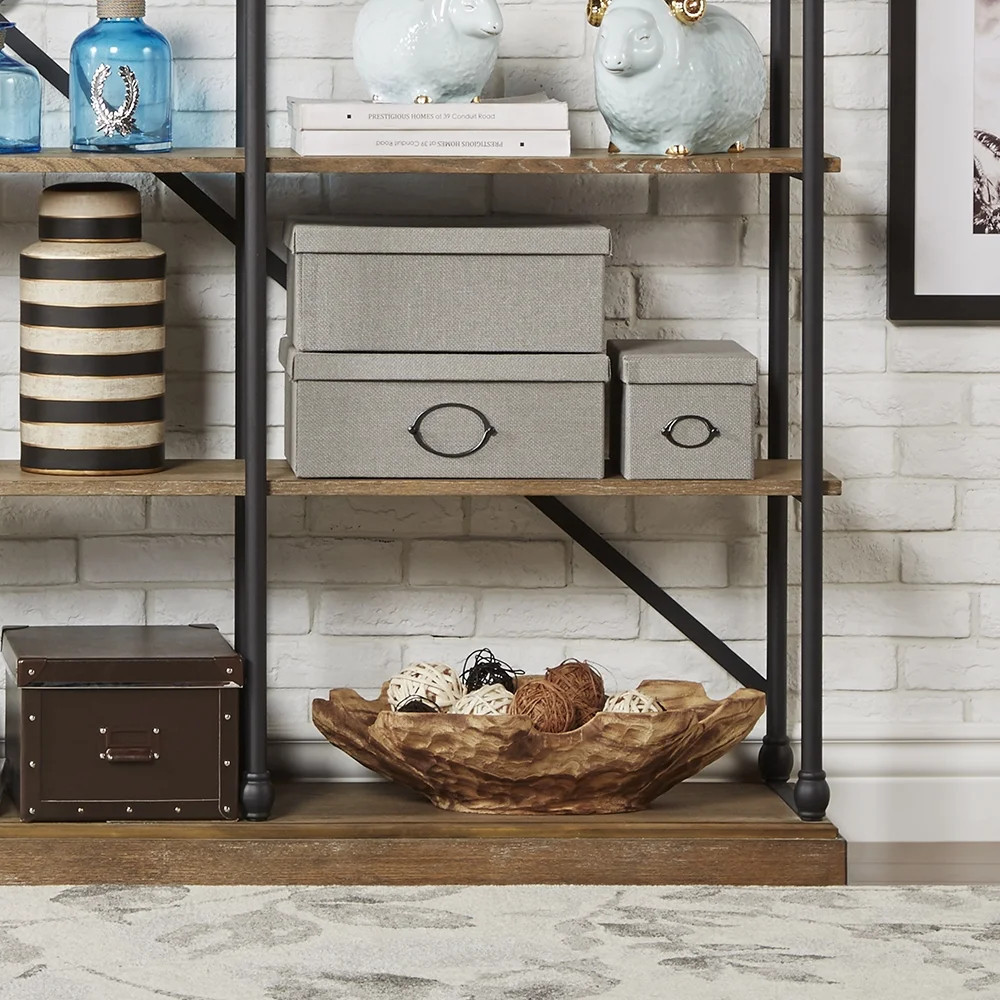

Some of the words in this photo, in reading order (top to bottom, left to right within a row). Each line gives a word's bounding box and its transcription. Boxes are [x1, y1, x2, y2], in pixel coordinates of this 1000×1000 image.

[368, 112, 410, 120] PRESTIGIOUS
[411, 112, 434, 120] HOMES
[443, 112, 451, 120] 39
[451, 112, 477, 120] Conduit
[478, 112, 496, 120] Road
[375, 140, 393, 148] Road
[394, 140, 420, 148] Conduit
[437, 140, 461, 148] HOMES
[462, 140, 503, 148] PRESTIGIOUS
